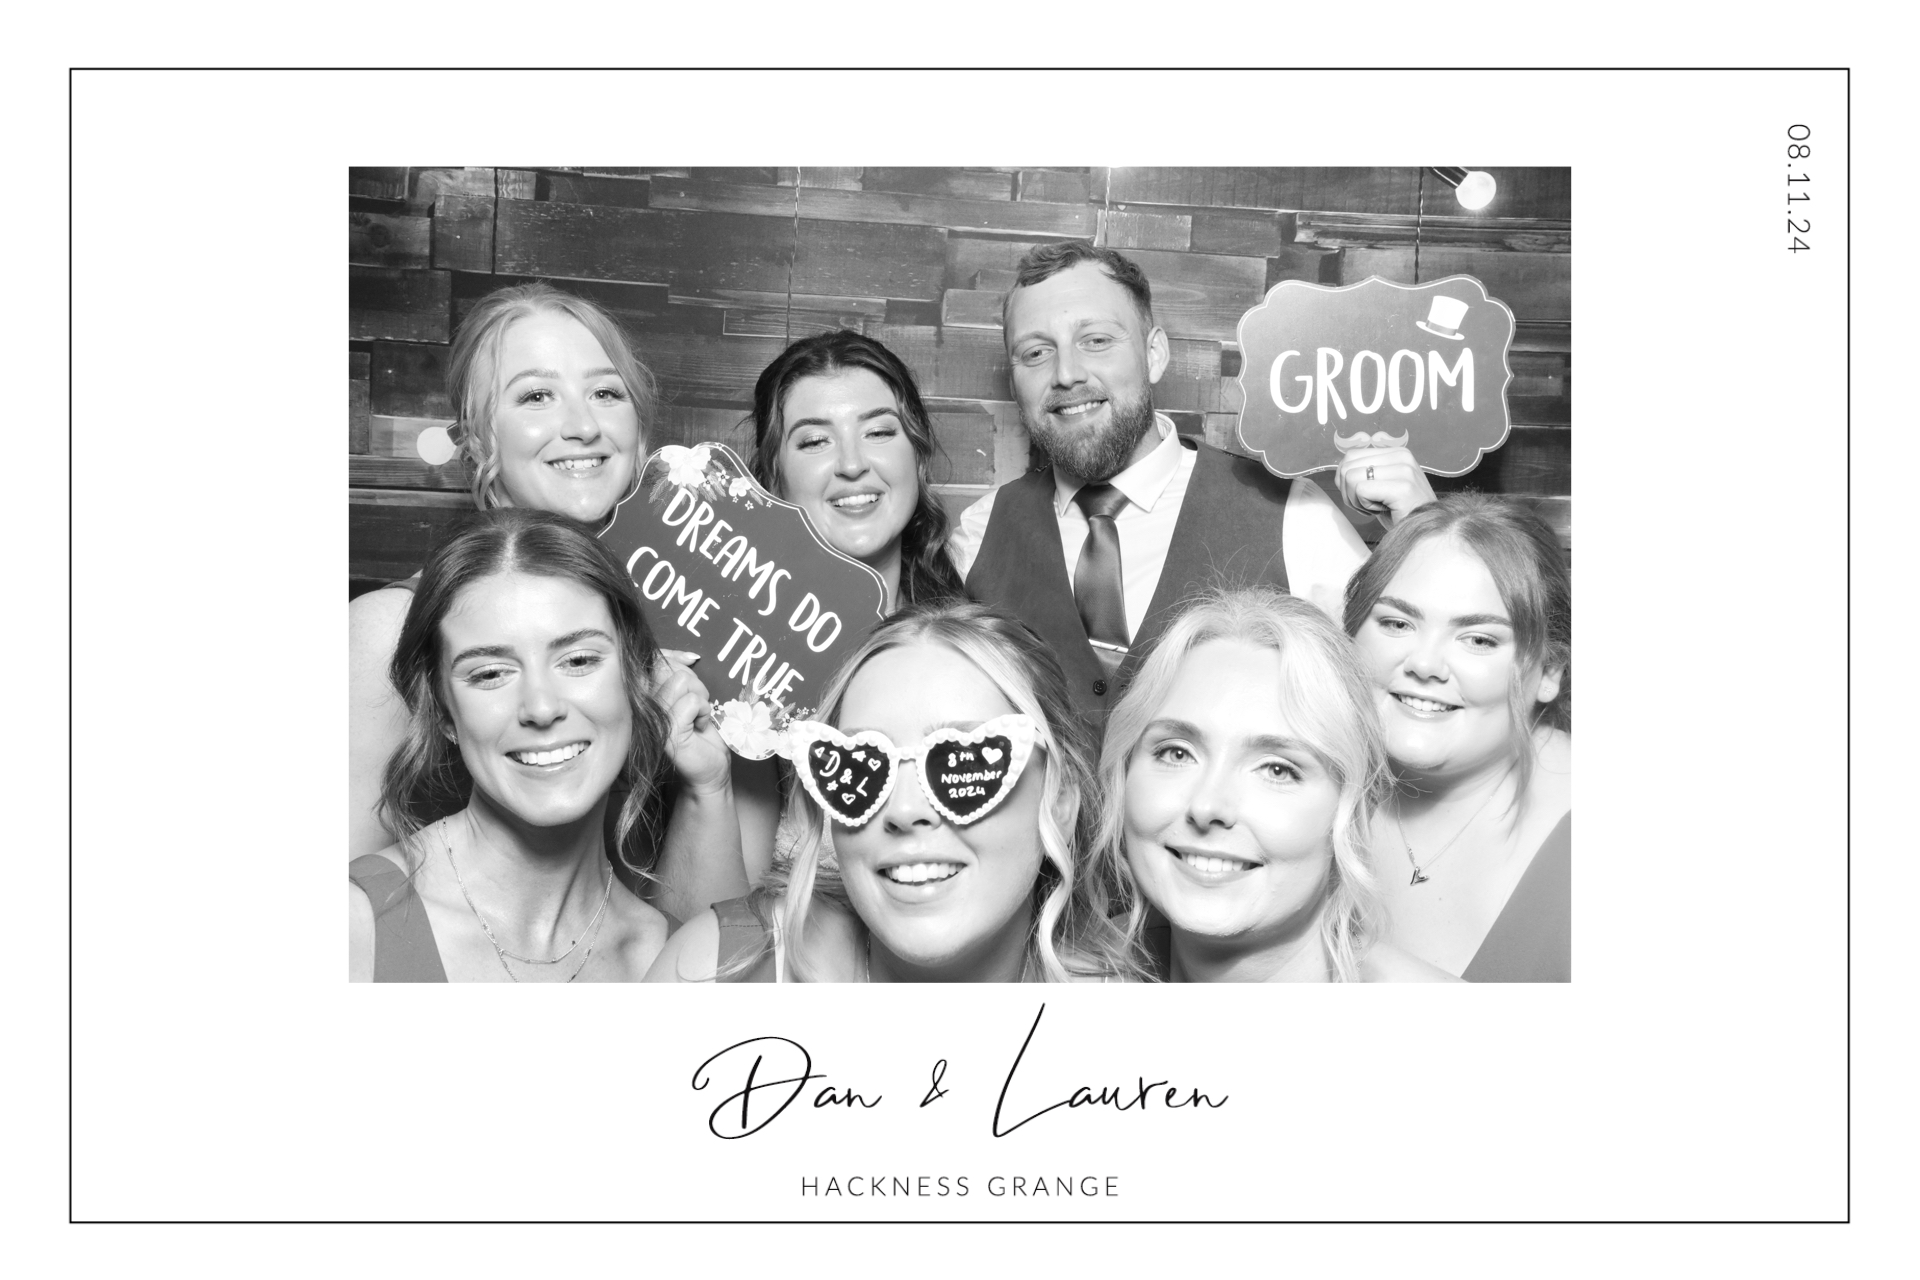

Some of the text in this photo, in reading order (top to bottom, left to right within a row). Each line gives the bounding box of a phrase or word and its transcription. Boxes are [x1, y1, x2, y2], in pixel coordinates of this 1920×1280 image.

[1269, 346, 1475, 425] GROOM
[661, 487, 842, 652] DREAMS DO
[626, 545, 804, 708] COME TRUE
[819, 750, 869, 797] D & L
[941, 769, 1003, 784] November
[948, 784, 986, 799] 2024
